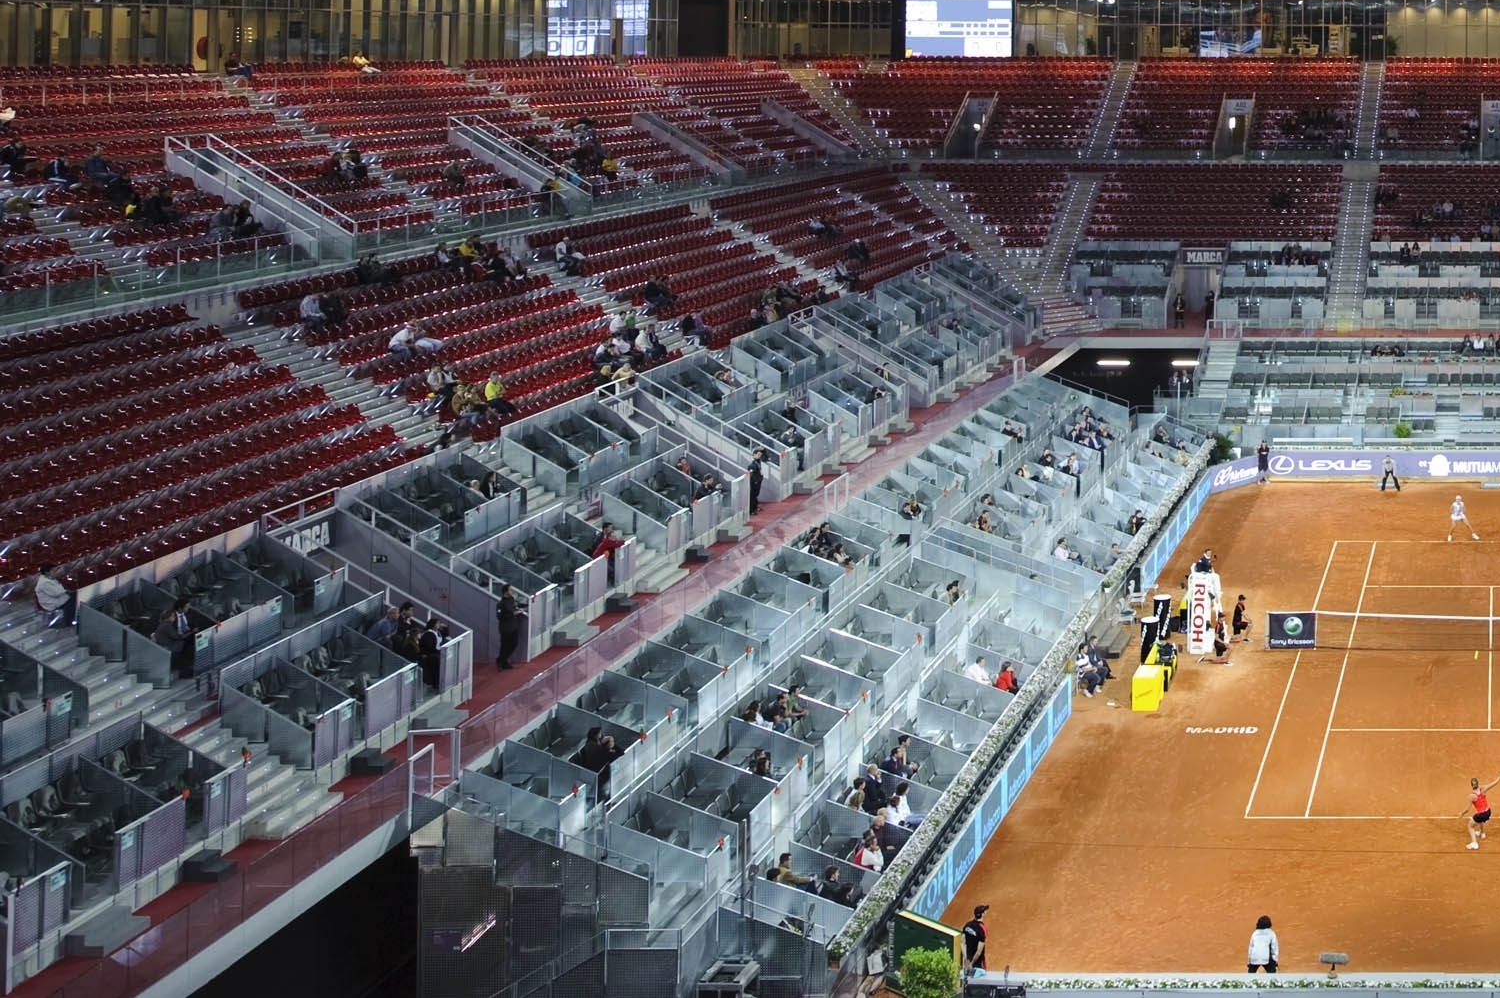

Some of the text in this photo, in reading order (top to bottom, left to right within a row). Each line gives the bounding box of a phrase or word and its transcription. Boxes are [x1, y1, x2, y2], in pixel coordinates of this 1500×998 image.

[1186, 251, 1223, 263] MARCA
[1299, 459, 1373, 471] LEXUS
[1192, 583, 1206, 643] RICOH
[1270, 638, 1287, 646] Sony
[1185, 726, 1258, 734] MADRID
